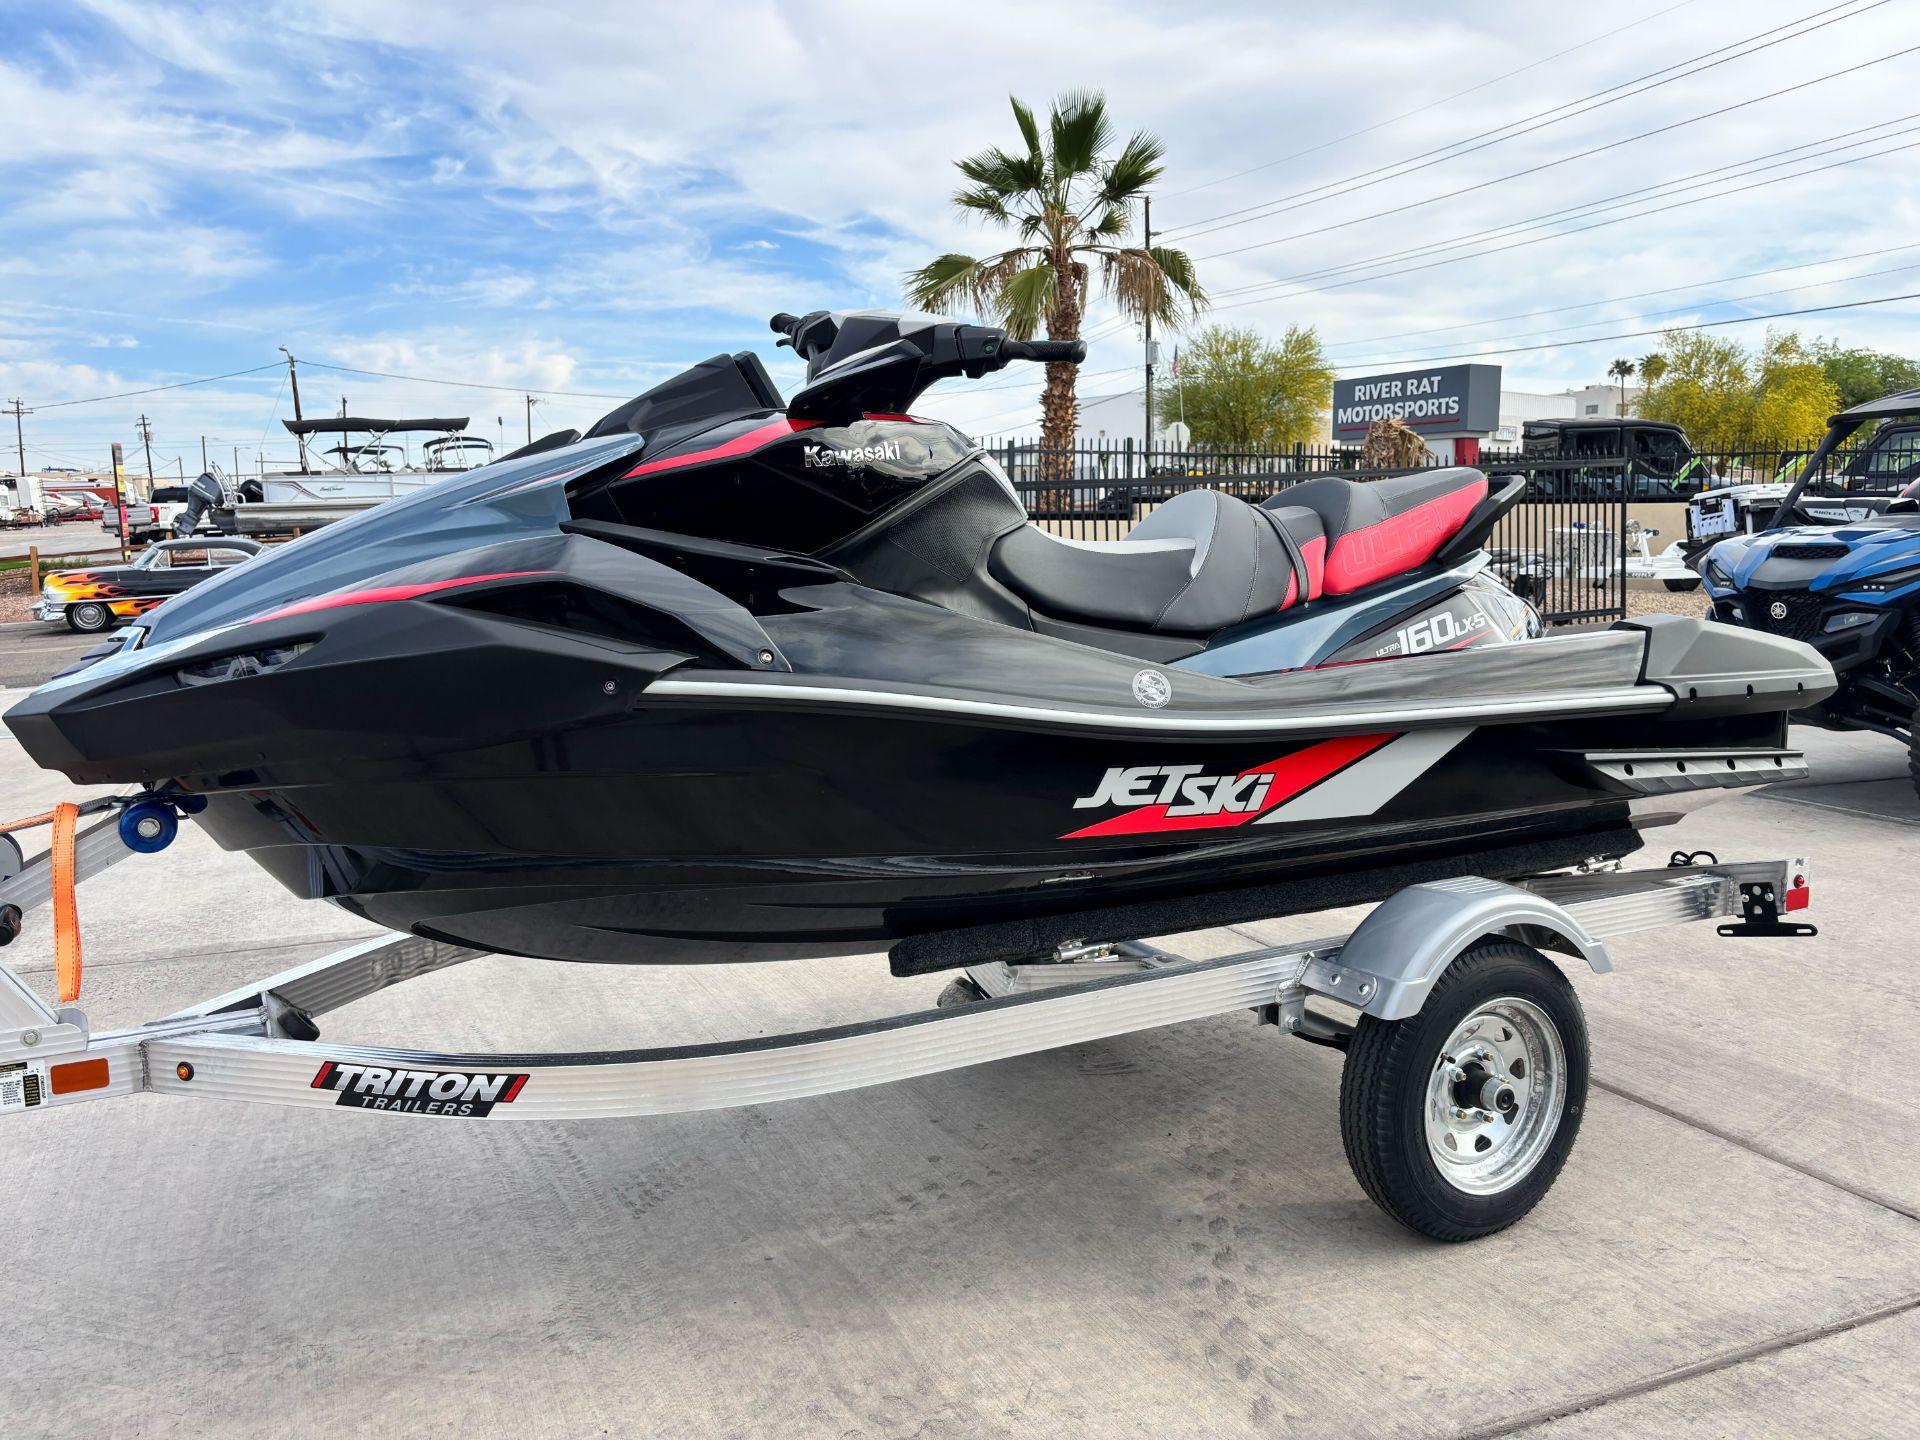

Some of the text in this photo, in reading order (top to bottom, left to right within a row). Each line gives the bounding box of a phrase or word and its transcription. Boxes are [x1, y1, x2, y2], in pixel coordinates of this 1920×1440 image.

[1354, 376, 1442, 401] RIVER RAT
[1337, 396, 1460, 424] MOTORSPORTS
[803, 440, 901, 467] Kawasaki
[1375, 642, 1401, 657] ULTRA
[334, 1063, 508, 1101] TRITON
[361, 1096, 474, 1116] TRAILERS
